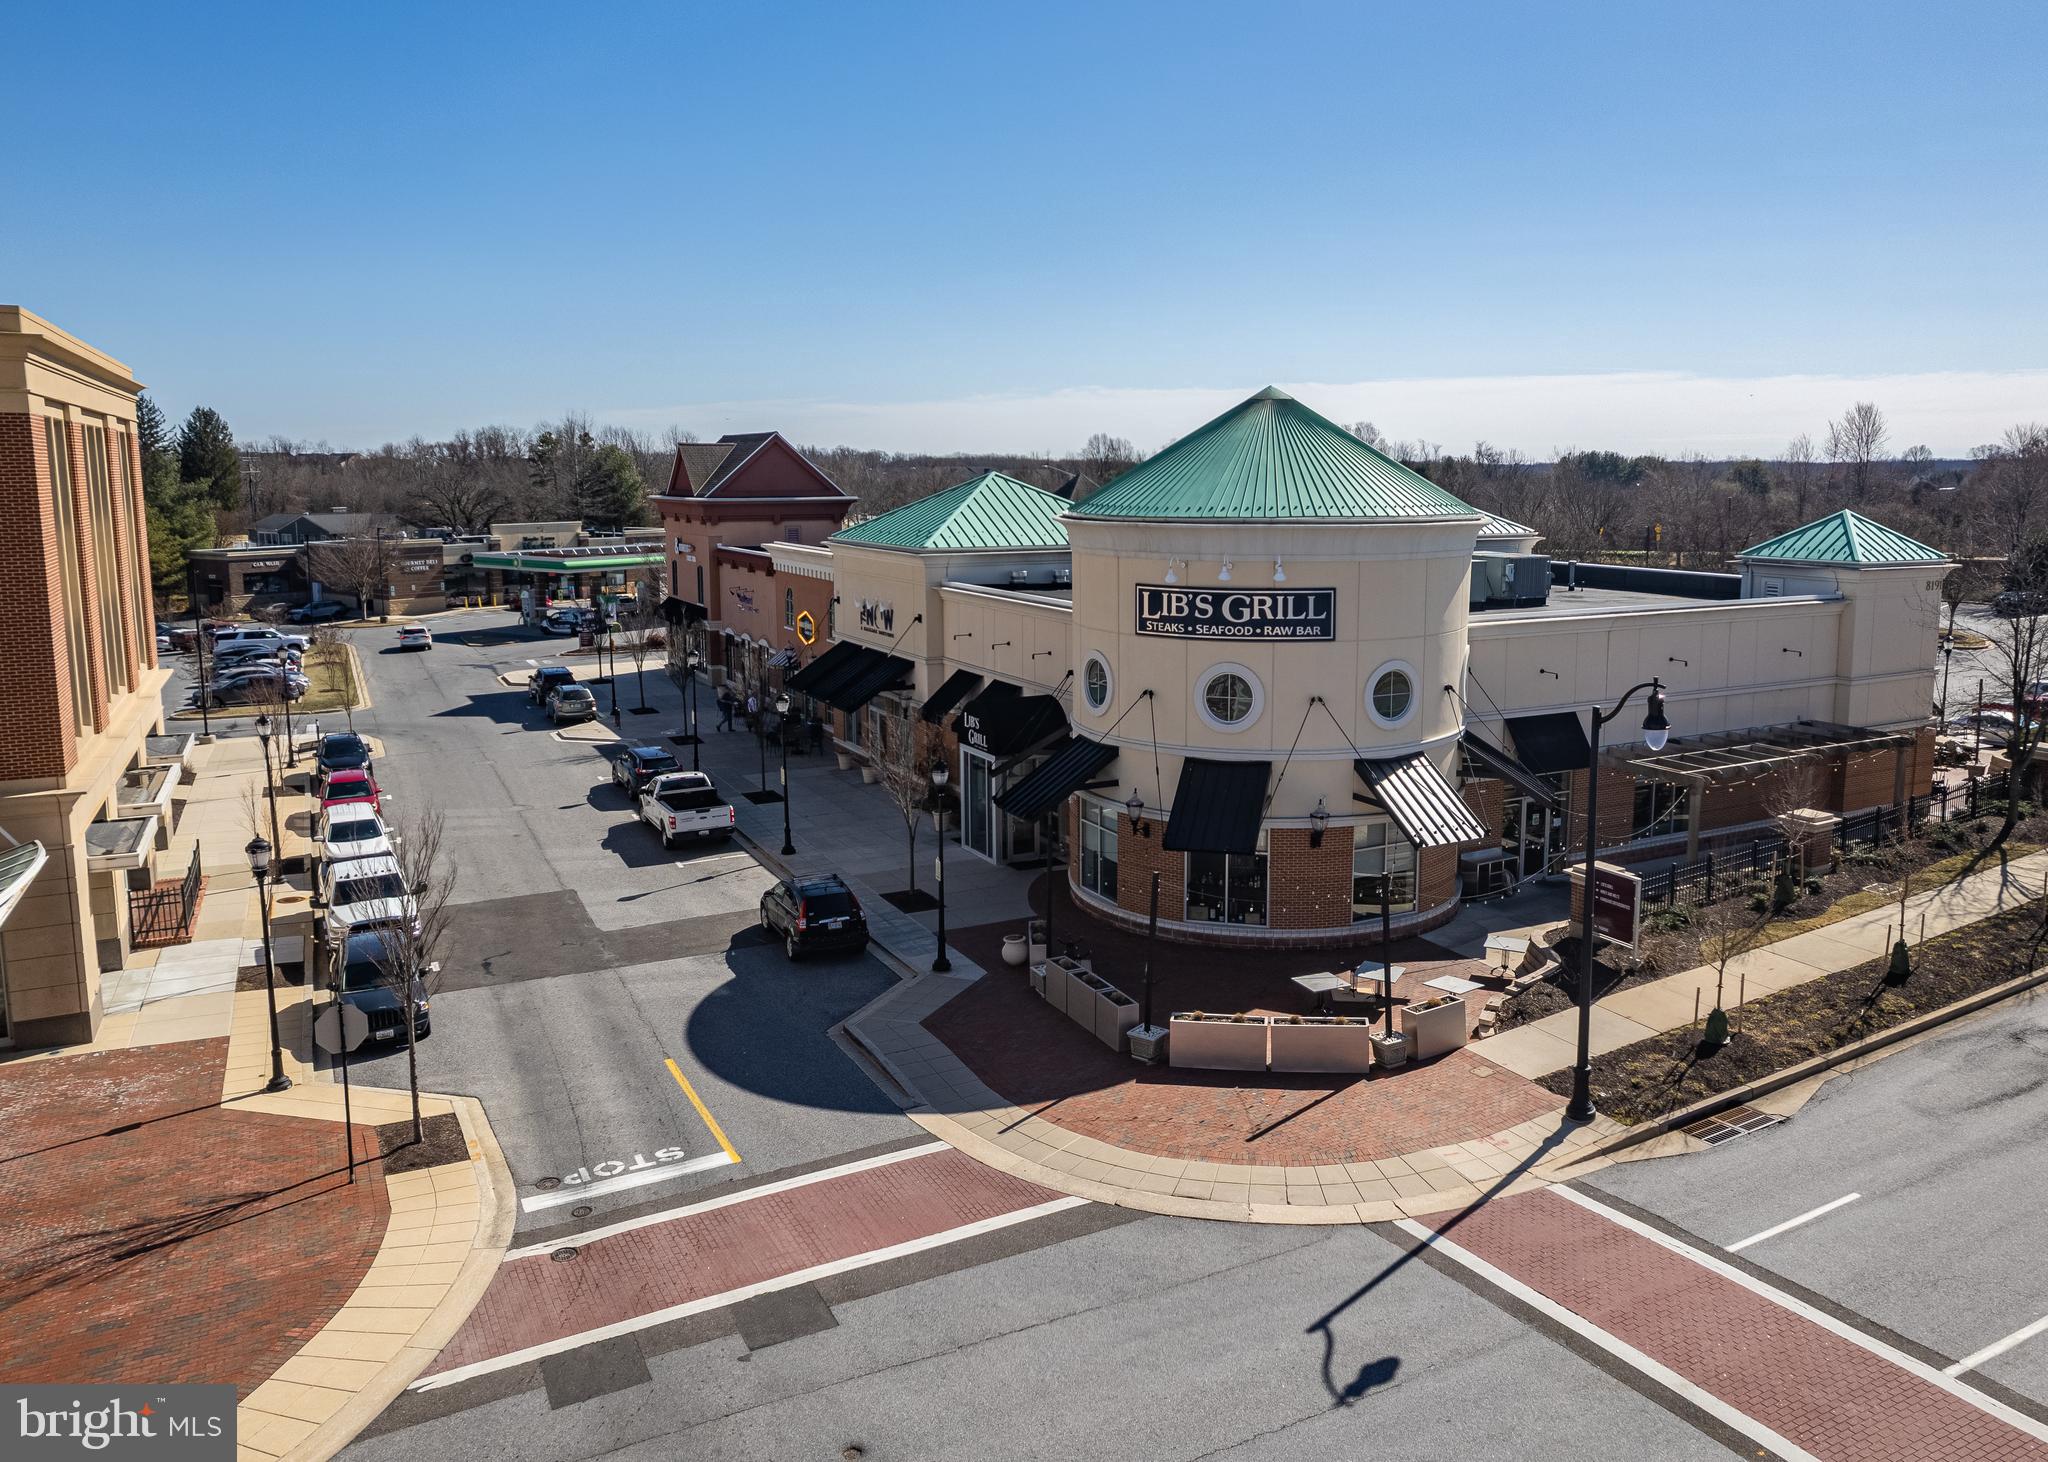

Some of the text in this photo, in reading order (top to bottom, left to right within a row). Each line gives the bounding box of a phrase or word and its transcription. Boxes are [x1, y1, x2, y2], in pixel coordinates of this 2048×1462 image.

[1141, 591, 1327, 623] LIB'S GRILL
[1146, 620, 1321, 636] STEAKS SEAFOOD RAW BAR
[964, 712, 980, 730] LIB'S
[968, 729, 988, 748] GRILL
[563, 1146, 685, 1185] STOP
